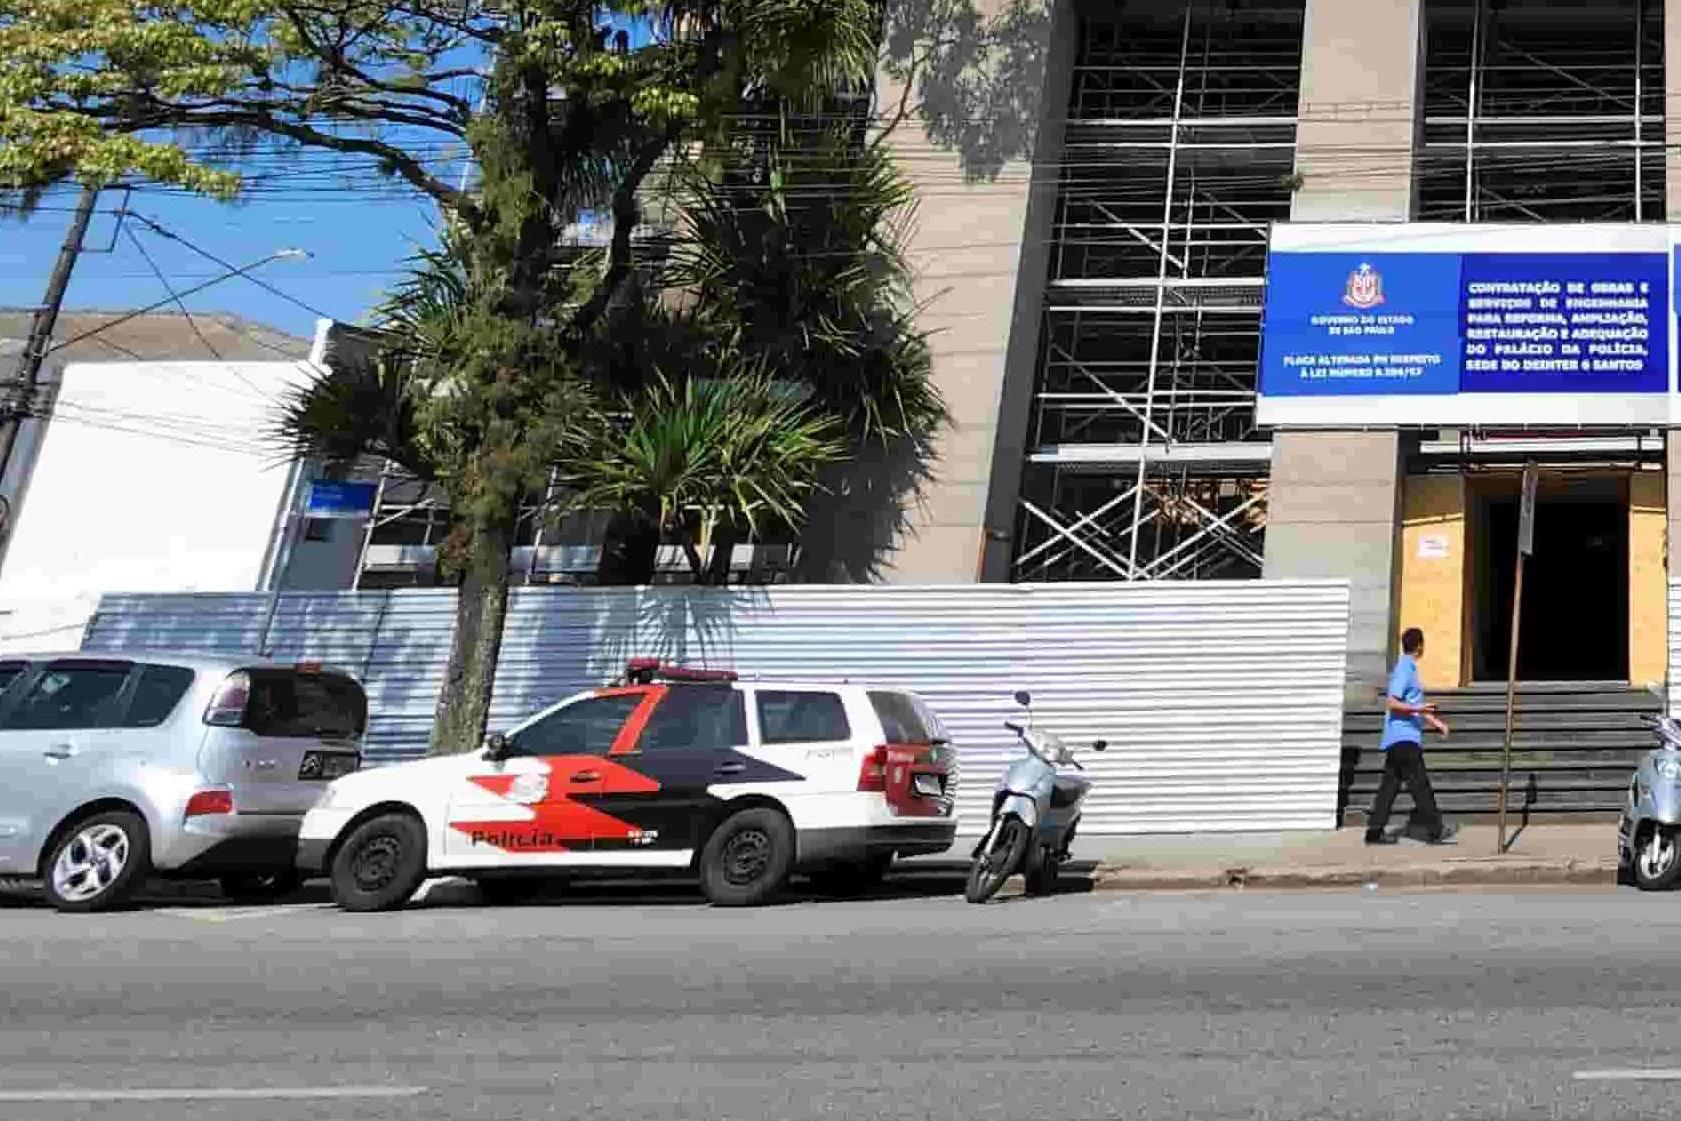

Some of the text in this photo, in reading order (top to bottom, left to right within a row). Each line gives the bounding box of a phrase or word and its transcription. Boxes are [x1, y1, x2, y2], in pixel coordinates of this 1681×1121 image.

[1468, 281, 1649, 295] CONTRATAÇÃO DE OBRAS E
[1539, 298, 1558, 309] DE
[1565, 297, 1649, 309] ENGENHARIA
[1467, 312, 1500, 324] PARA
[1466, 327, 1648, 341] RESTAURAÇÃO E ADEQUAÇÃO
[1466, 344, 1486, 355] DO
[1495, 342, 1553, 355] PALÁCIO
[1561, 344, 1580, 354] DA
[1465, 359, 1498, 371] SEDE
[1501, 359, 1521, 371] DO
[1593, 359, 1643, 371] SANTOS
